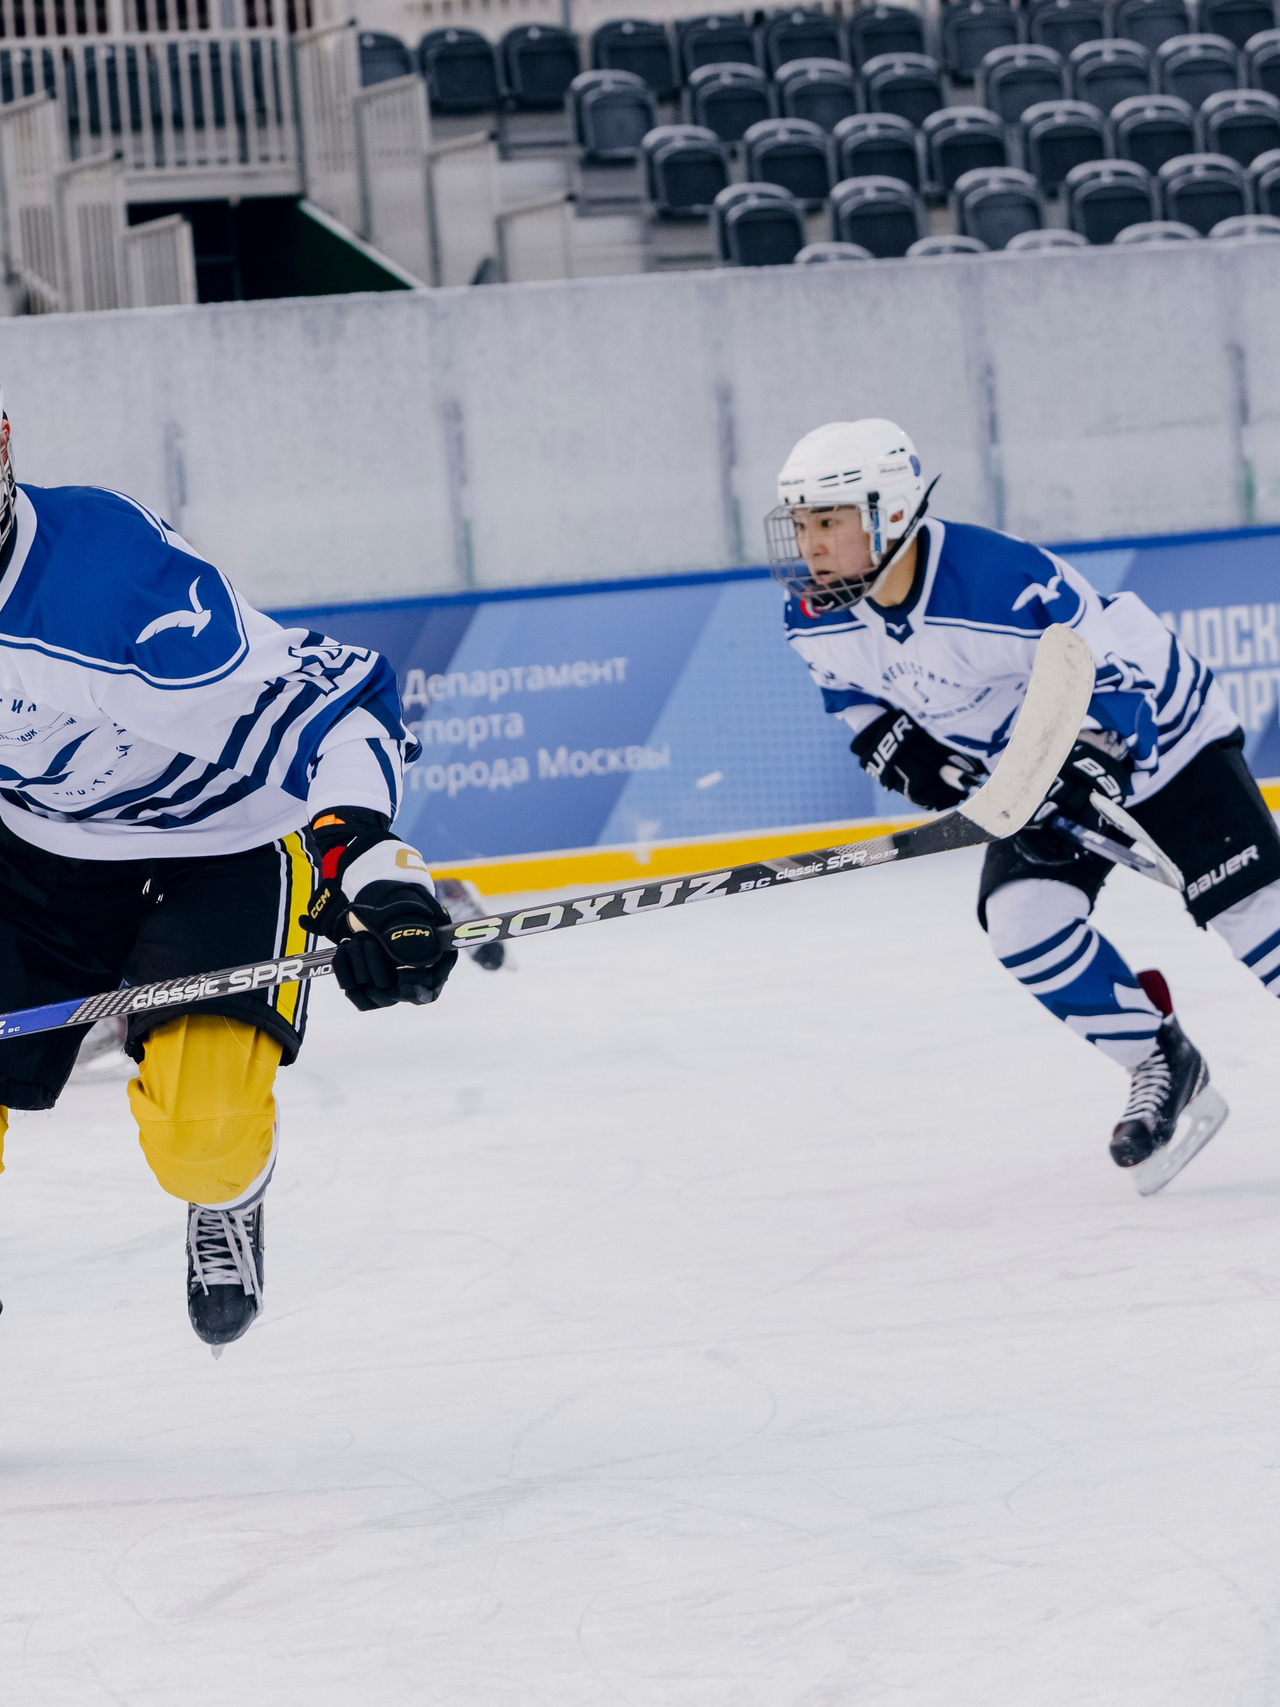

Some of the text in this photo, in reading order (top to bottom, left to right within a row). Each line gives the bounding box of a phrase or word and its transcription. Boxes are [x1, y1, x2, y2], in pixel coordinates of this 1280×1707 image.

[403, 656, 628, 712] Департамент
[407, 711, 525, 751] спорта
[410, 743, 671, 798] города Москвы
[310, 887, 331, 919] CCM
[451, 869, 733, 948] SOYUZ
[738, 876, 772, 893] BC
[775, 861, 824, 881] classic
[826, 849, 868, 870] SPR
[391, 928, 430, 942] CCM
[132, 976, 221, 1011] classic
[228, 958, 304, 993] SPR
